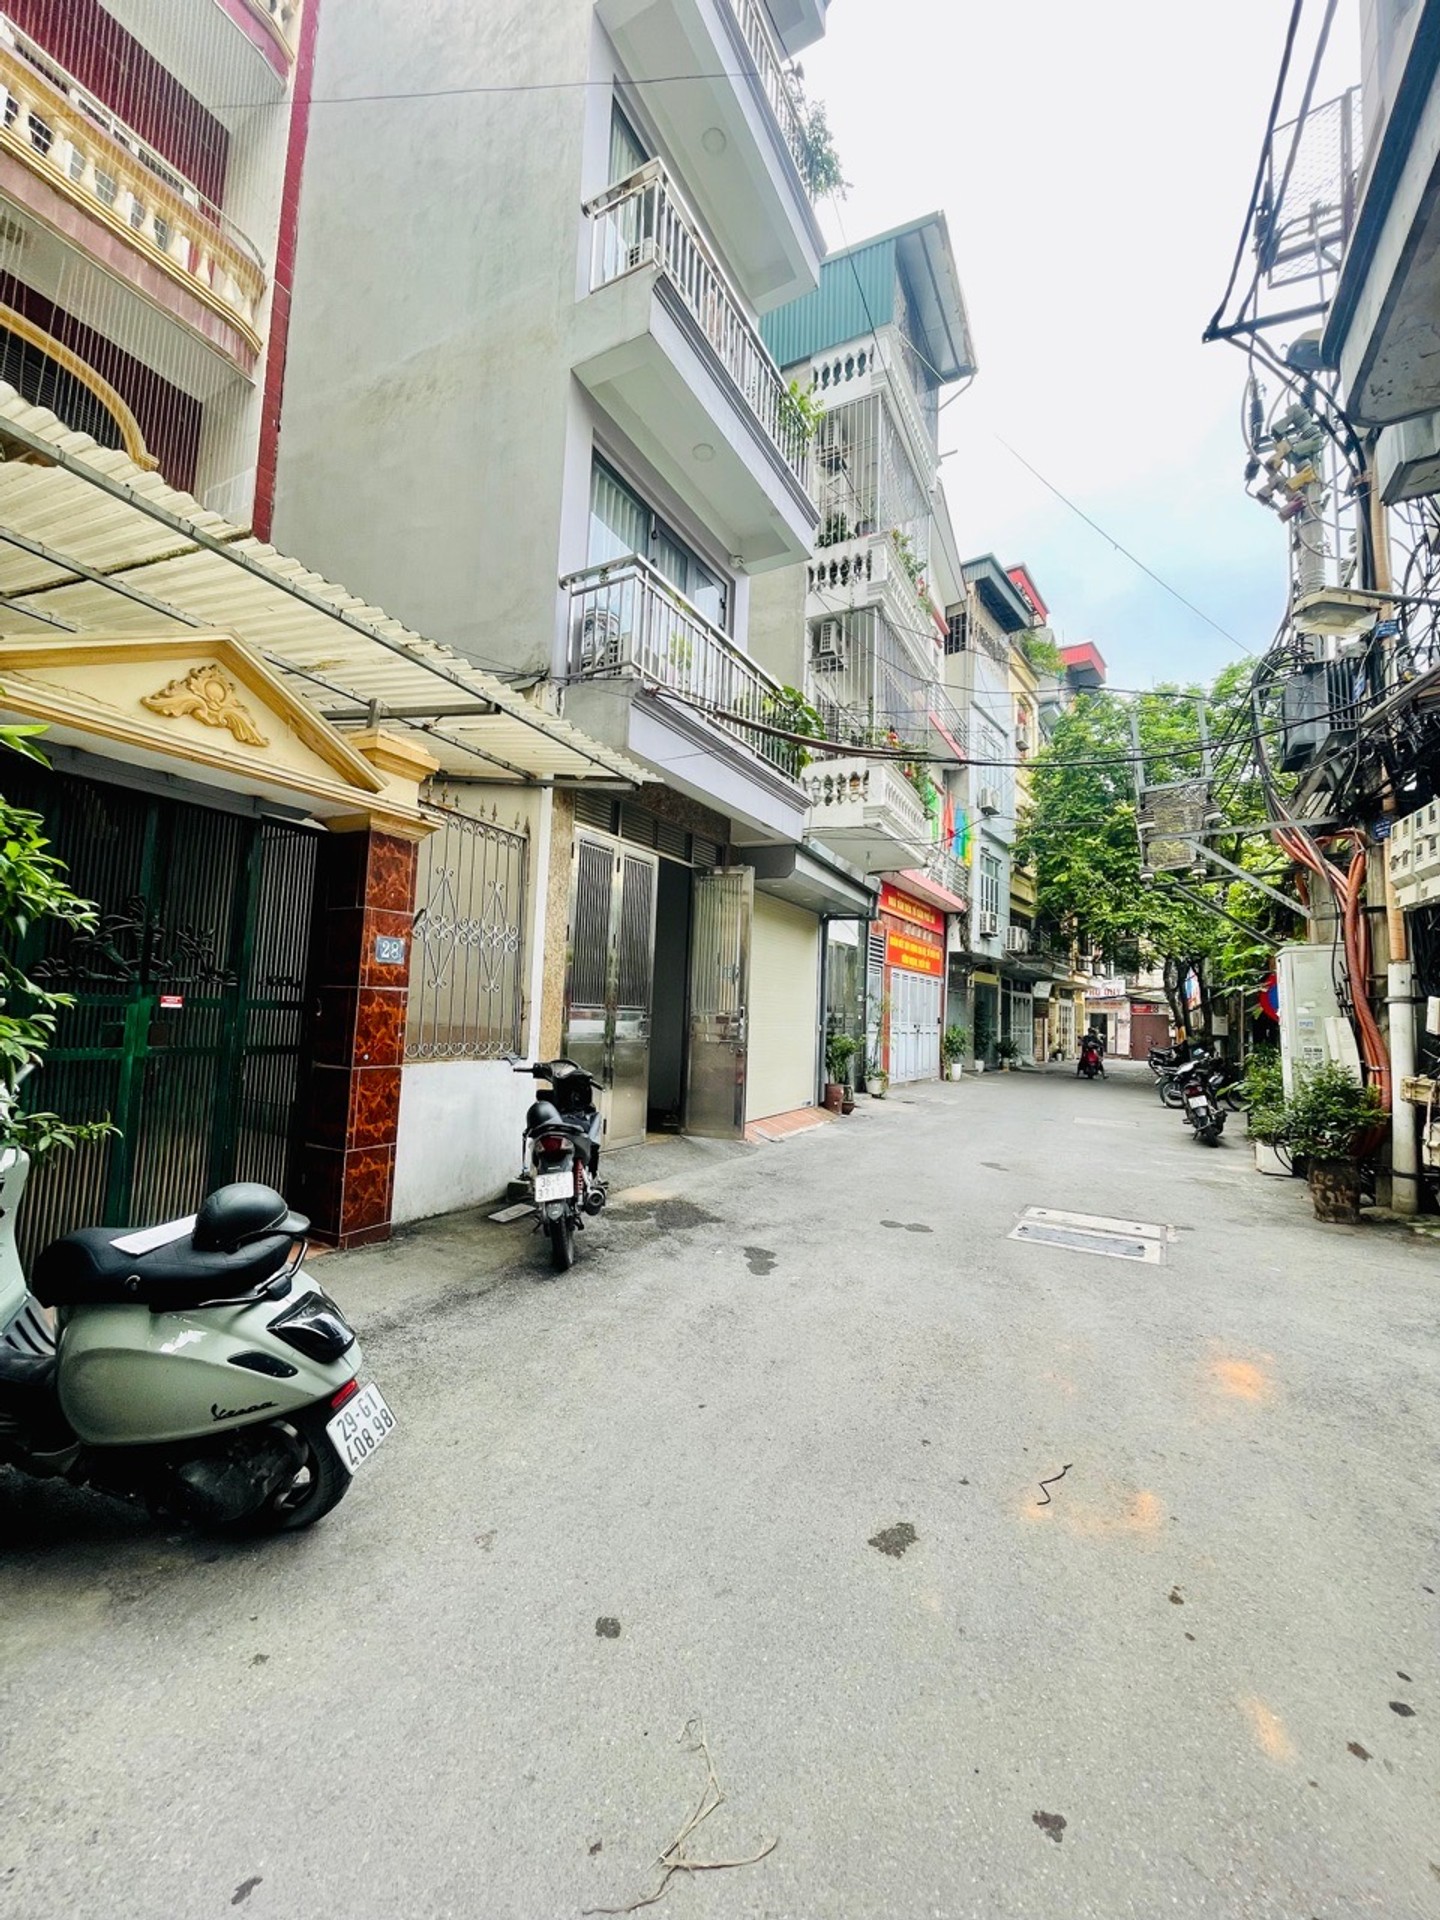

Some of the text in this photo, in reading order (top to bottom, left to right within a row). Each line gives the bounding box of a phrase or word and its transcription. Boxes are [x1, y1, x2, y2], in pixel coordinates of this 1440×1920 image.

[381, 940, 399, 960] 28
[211, 1403, 279, 1421] Vespa
[336, 1391, 378, 1442] 29-G1
[349, 1408, 393, 1466] 408.98
